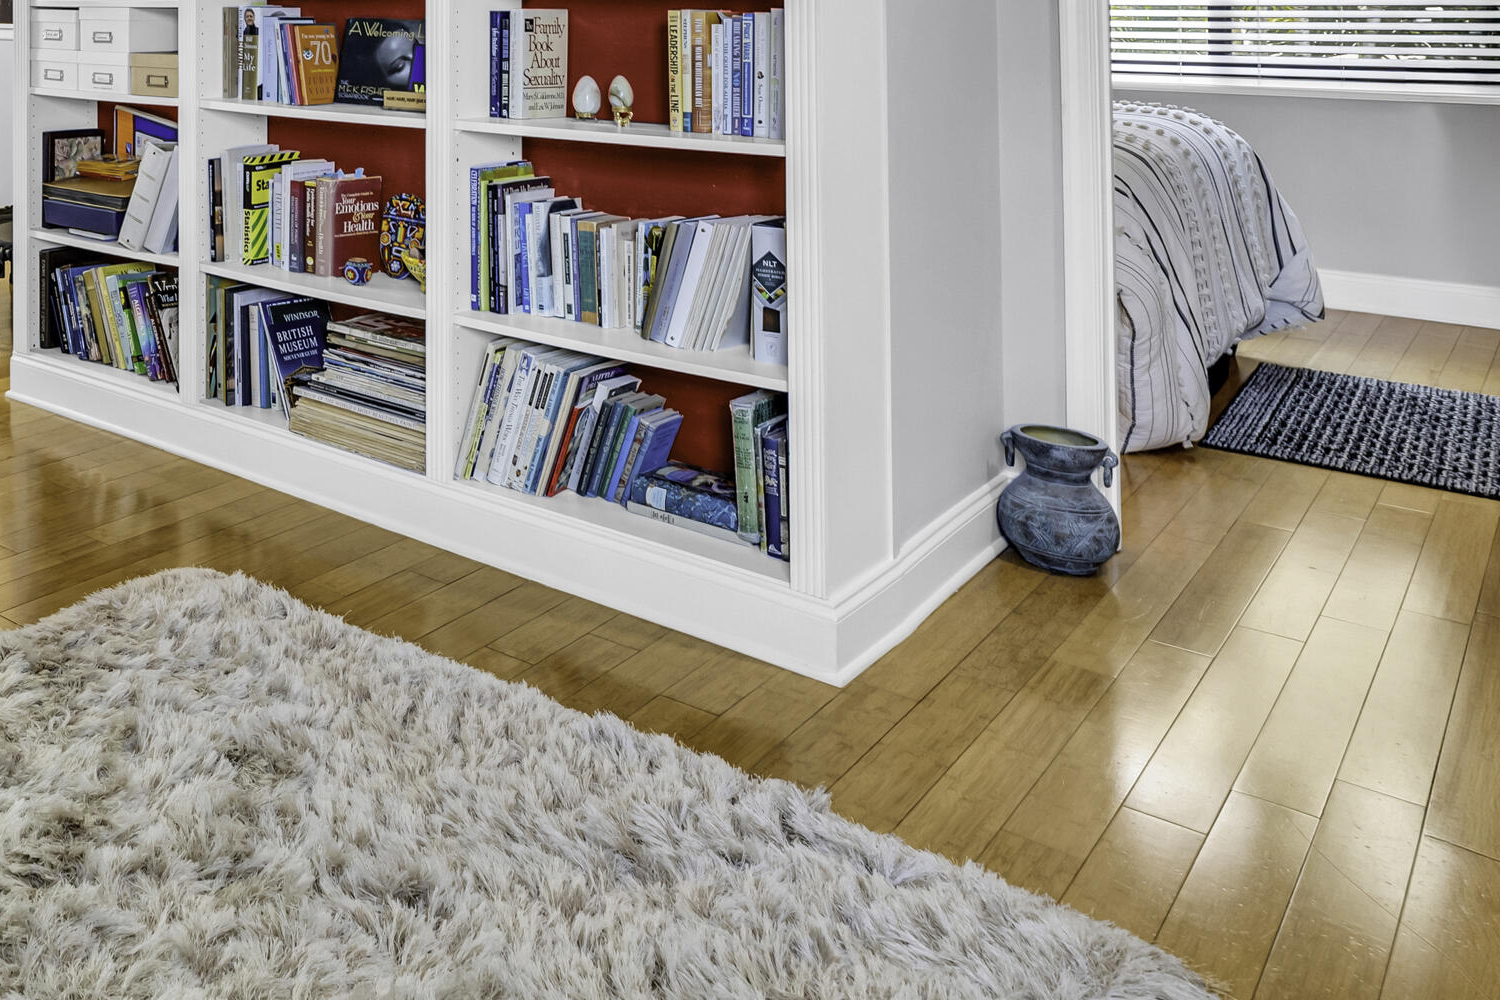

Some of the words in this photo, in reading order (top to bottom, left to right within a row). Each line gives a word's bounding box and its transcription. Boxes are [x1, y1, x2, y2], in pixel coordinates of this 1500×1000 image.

[349, 21, 362, 36] A
[363, 21, 415, 41] Welcoming
[534, 17, 564, 38] Family
[529, 35, 553, 52] Book
[733, 21, 741, 56] BREAKING
[244, 53, 254, 62] My
[309, 41, 330, 65] 70
[669, 24, 678, 75] LEADERSHIP
[531, 52, 560, 69] About
[523, 68, 564, 87] Sexuality
[733, 72, 741, 86] NO
[670, 94, 679, 113] LINE
[335, 200, 379, 215] Emotions
[341, 195, 356, 205] Your
[343, 219, 374, 233] Health
[352, 212, 360, 223] &
[361, 212, 375, 220] Your
[763, 260, 777, 268] NLT
[283, 311, 319, 323] WINDSOR
[276, 325, 314, 342] BRITISH
[279, 337, 318, 354] MUSEUM
[283, 353, 305, 361] SOUVENIR
[305, 349, 318, 357] GUIDE
